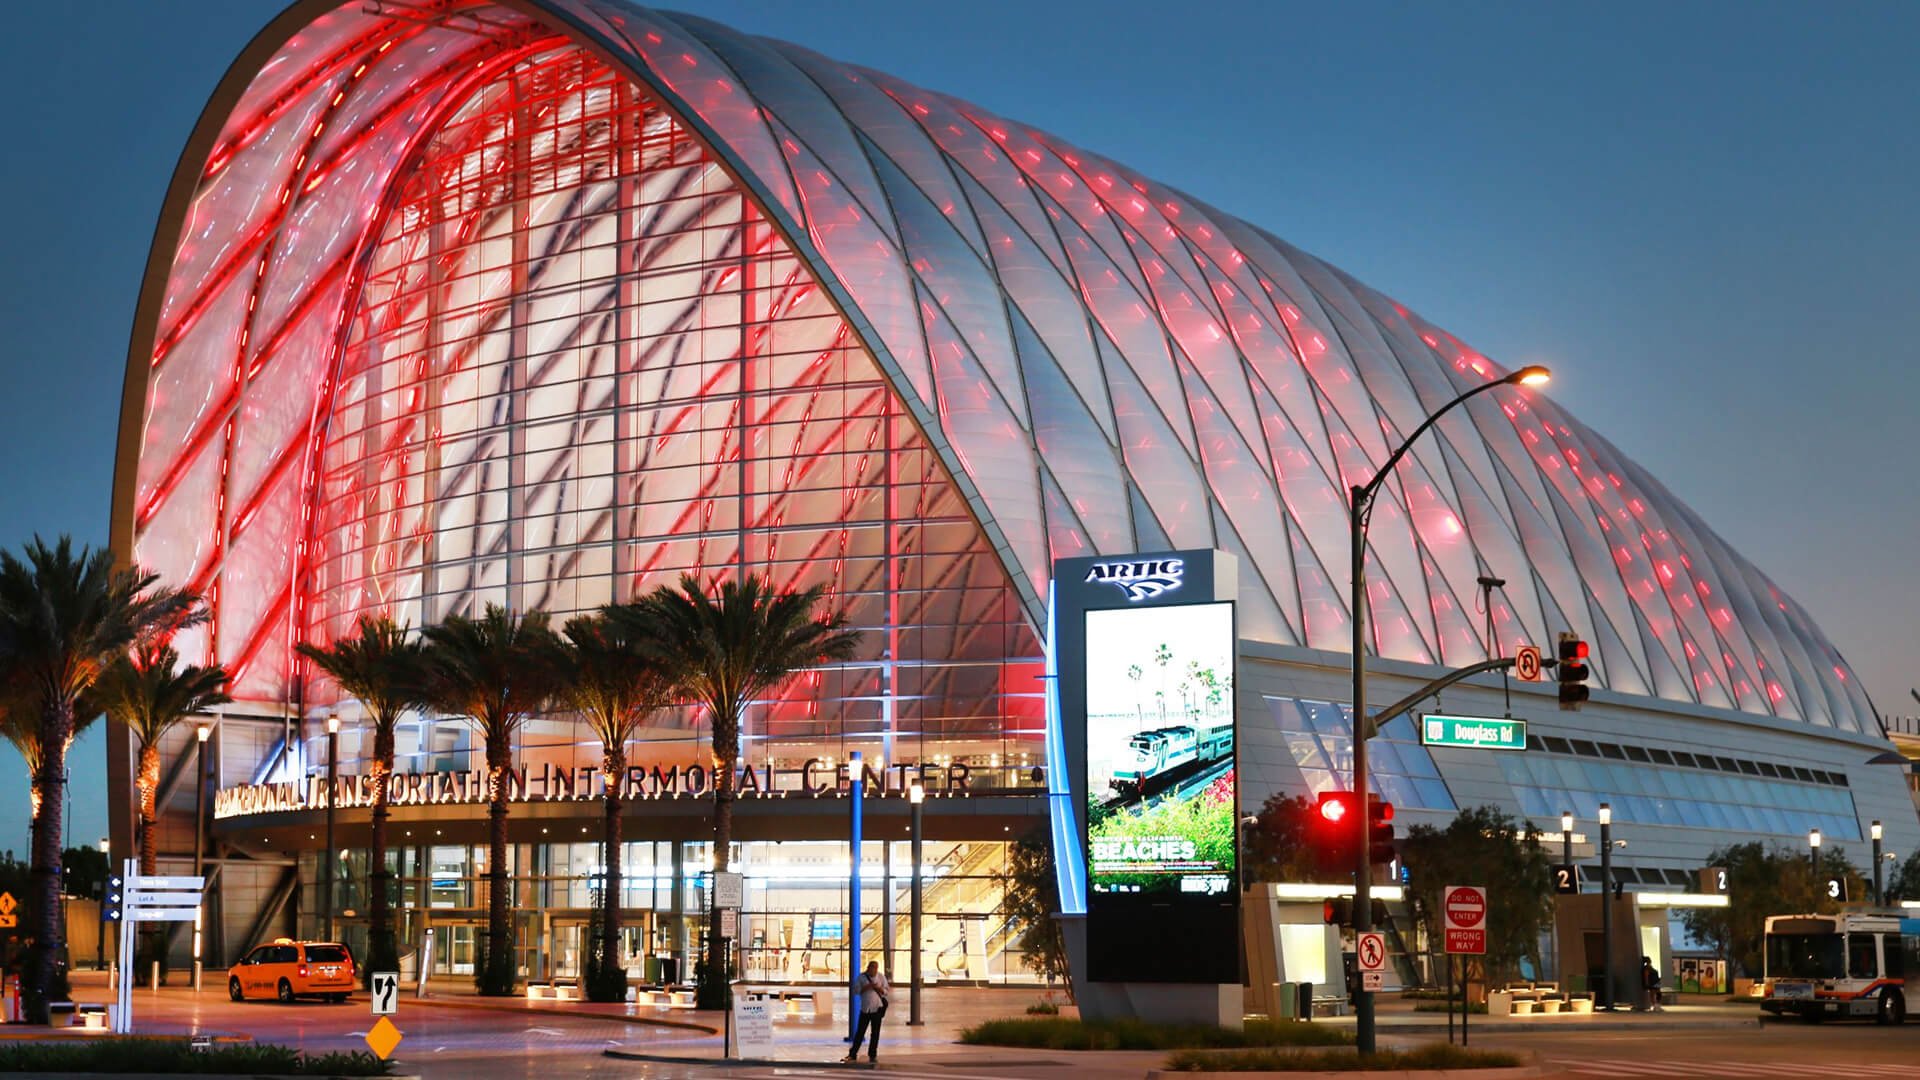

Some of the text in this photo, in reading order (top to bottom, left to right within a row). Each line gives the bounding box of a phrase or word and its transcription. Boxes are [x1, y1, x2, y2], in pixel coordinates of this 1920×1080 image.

[1083, 559, 1183, 581] ARTIC
[1454, 723, 1513, 745] Douglass Rd
[543, 762, 787, 799] INTRMOAL
[802, 758, 970, 798] CENTER
[1094, 841, 1195, 860] BEACHES
[1389, 859, 1397, 881] 1
[1557, 870, 1570, 888] 2
[1718, 871, 1726, 890] 2
[1828, 880, 1840, 898] 3
[1465, 895, 1479, 903] NOT
[1454, 912, 1478, 920] ENTER
[1450, 932, 1481, 941] WRONG
[1455, 941, 1475, 950] WAY
